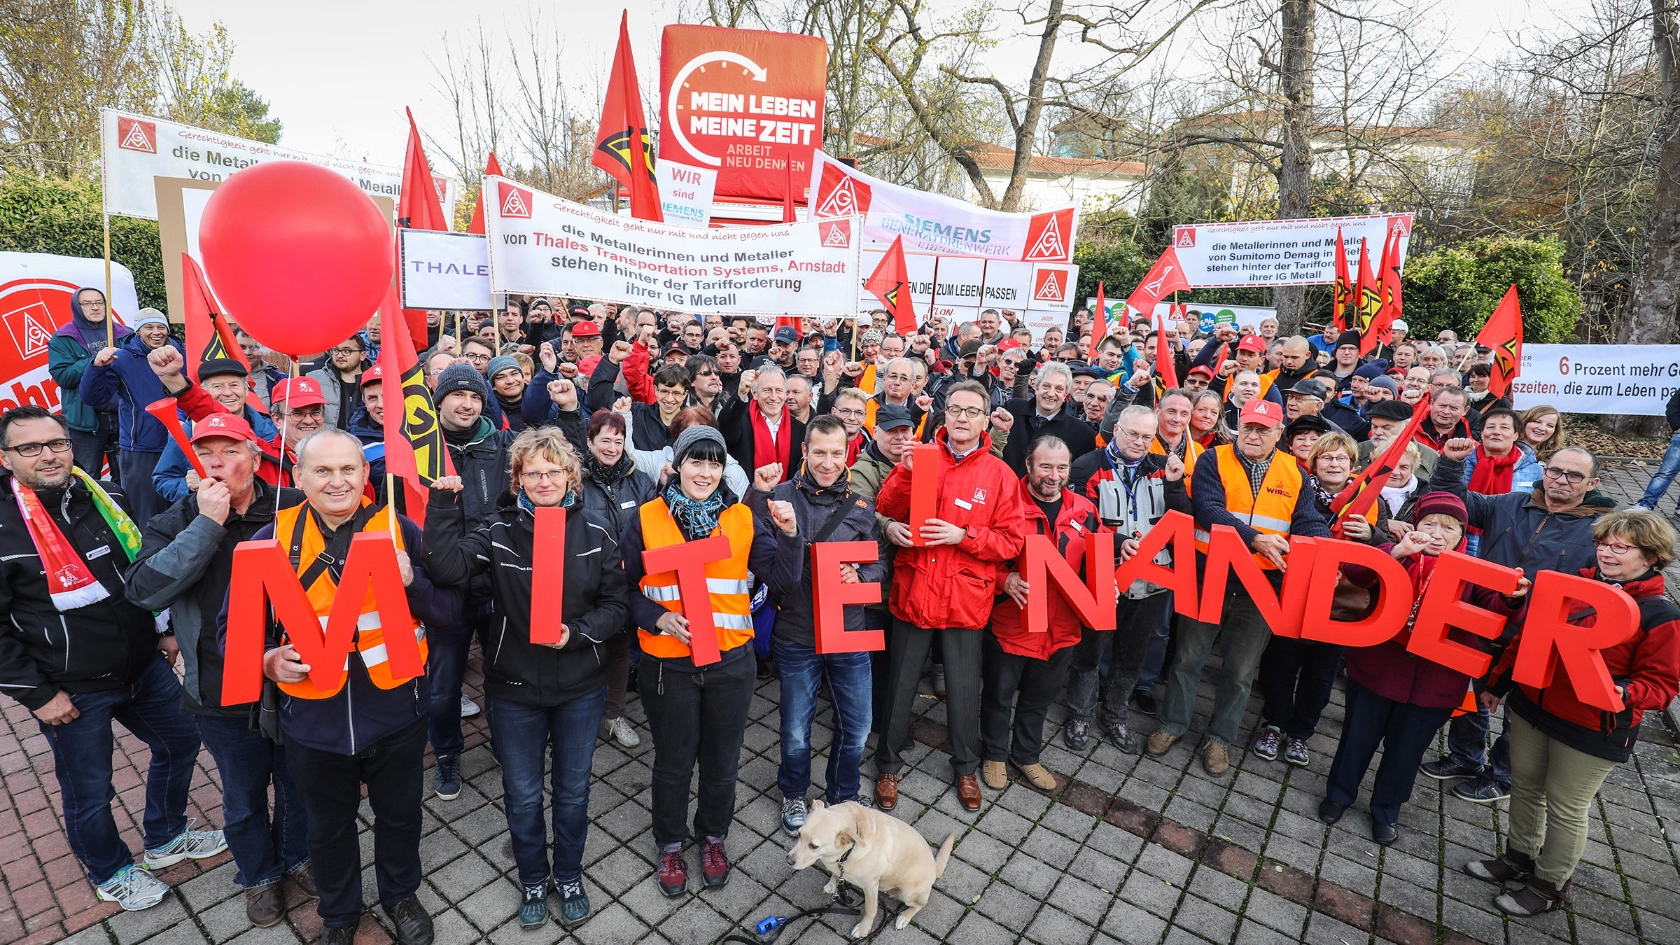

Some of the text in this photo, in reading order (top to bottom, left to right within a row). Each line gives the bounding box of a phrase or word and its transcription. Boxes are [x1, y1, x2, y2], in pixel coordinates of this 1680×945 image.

[691, 91, 816, 118] MEIN LEBEN
[690, 115, 815, 145] MEINE ZEIT
[178, 131, 246, 151] Gerechtigkeit
[250, 145, 270, 155] geht
[727, 144, 771, 156] ARBEIT
[172, 146, 200, 162] die
[727, 157, 751, 168] NEU
[188, 169, 222, 182] von
[672, 167, 702, 186] WIR
[673, 189, 695, 200] sind
[662, 202, 704, 219] IEMENS
[553, 203, 790, 242] Gerechtigkeit geht nur mit und nicht gegen uns
[904, 213, 992, 243] SIEMENS
[1207, 225, 1249, 234] Gerechtigkeit
[1251, 225, 1265, 233] geht
[562, 224, 795, 263] die Metallerinnen und Metaller
[882, 217, 1011, 256] GENERATORENWERK
[1212, 243, 1227, 251] die
[1229, 241, 1298, 250] Metallerinnen
[1301, 239, 1322, 248] und
[503, 231, 846, 279] von Thales Transportation Systems, Arnstadt
[1229, 252, 1281, 261] Sumitomo
[1284, 251, 1320, 260] Demag
[1323, 250, 1333, 258] in
[410, 260, 489, 276] THALE
[551, 255, 802, 292] stehen hinter der Tarifforderung
[1206, 263, 1239, 272] stehen
[1242, 262, 1271, 271] hinter
[1274, 262, 1291, 270] der
[1249, 271, 1321, 281] ihrer IG Metall
[626, 281, 737, 306] ihrer IG Metall
[919, 282, 933, 294] DIE
[936, 284, 954, 296] ZUM
[955, 284, 982, 298] LEBEN
[985, 287, 1018, 300] PASSEN
[1559, 355, 1570, 376] 6
[1574, 363, 1625, 376] Prozent
[1630, 362, 1665, 377] mehr
[1512, 380, 1559, 397] szeiten,
[1564, 381, 1583, 395] die
[1586, 384, 1613, 396] zum
[1616, 382, 1656, 397] Leben
[1267, 487, 1283, 495] WIR
